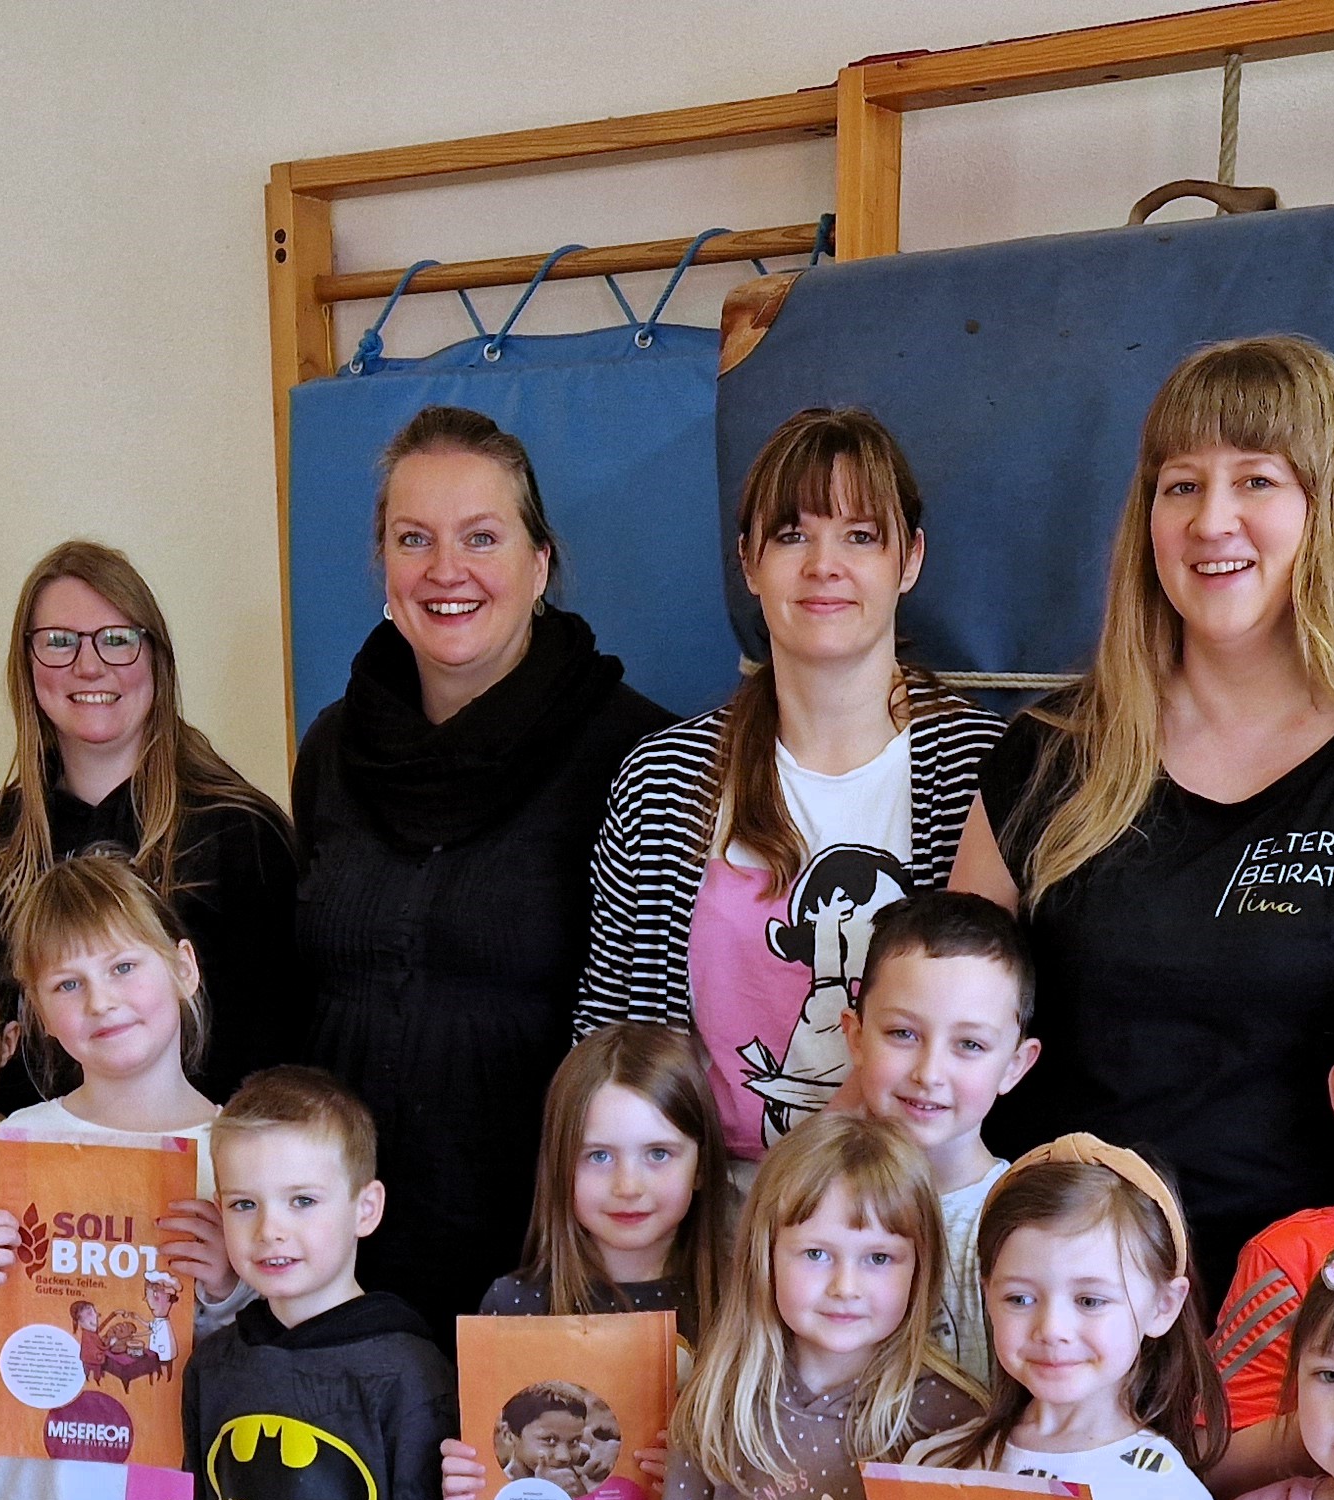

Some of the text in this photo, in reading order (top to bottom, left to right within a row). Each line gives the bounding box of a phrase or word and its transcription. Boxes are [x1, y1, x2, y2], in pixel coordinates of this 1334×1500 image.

[1235, 886, 1302, 915] Tina
[52, 1212, 133, 1243] SOLI
[51, 1239, 159, 1278] BROT
[35, 1275, 107, 1290] Backen. Teilen.
[35, 1285, 86, 1298] Gutes tun.
[47, 1420, 130, 1443] MISEREOR
